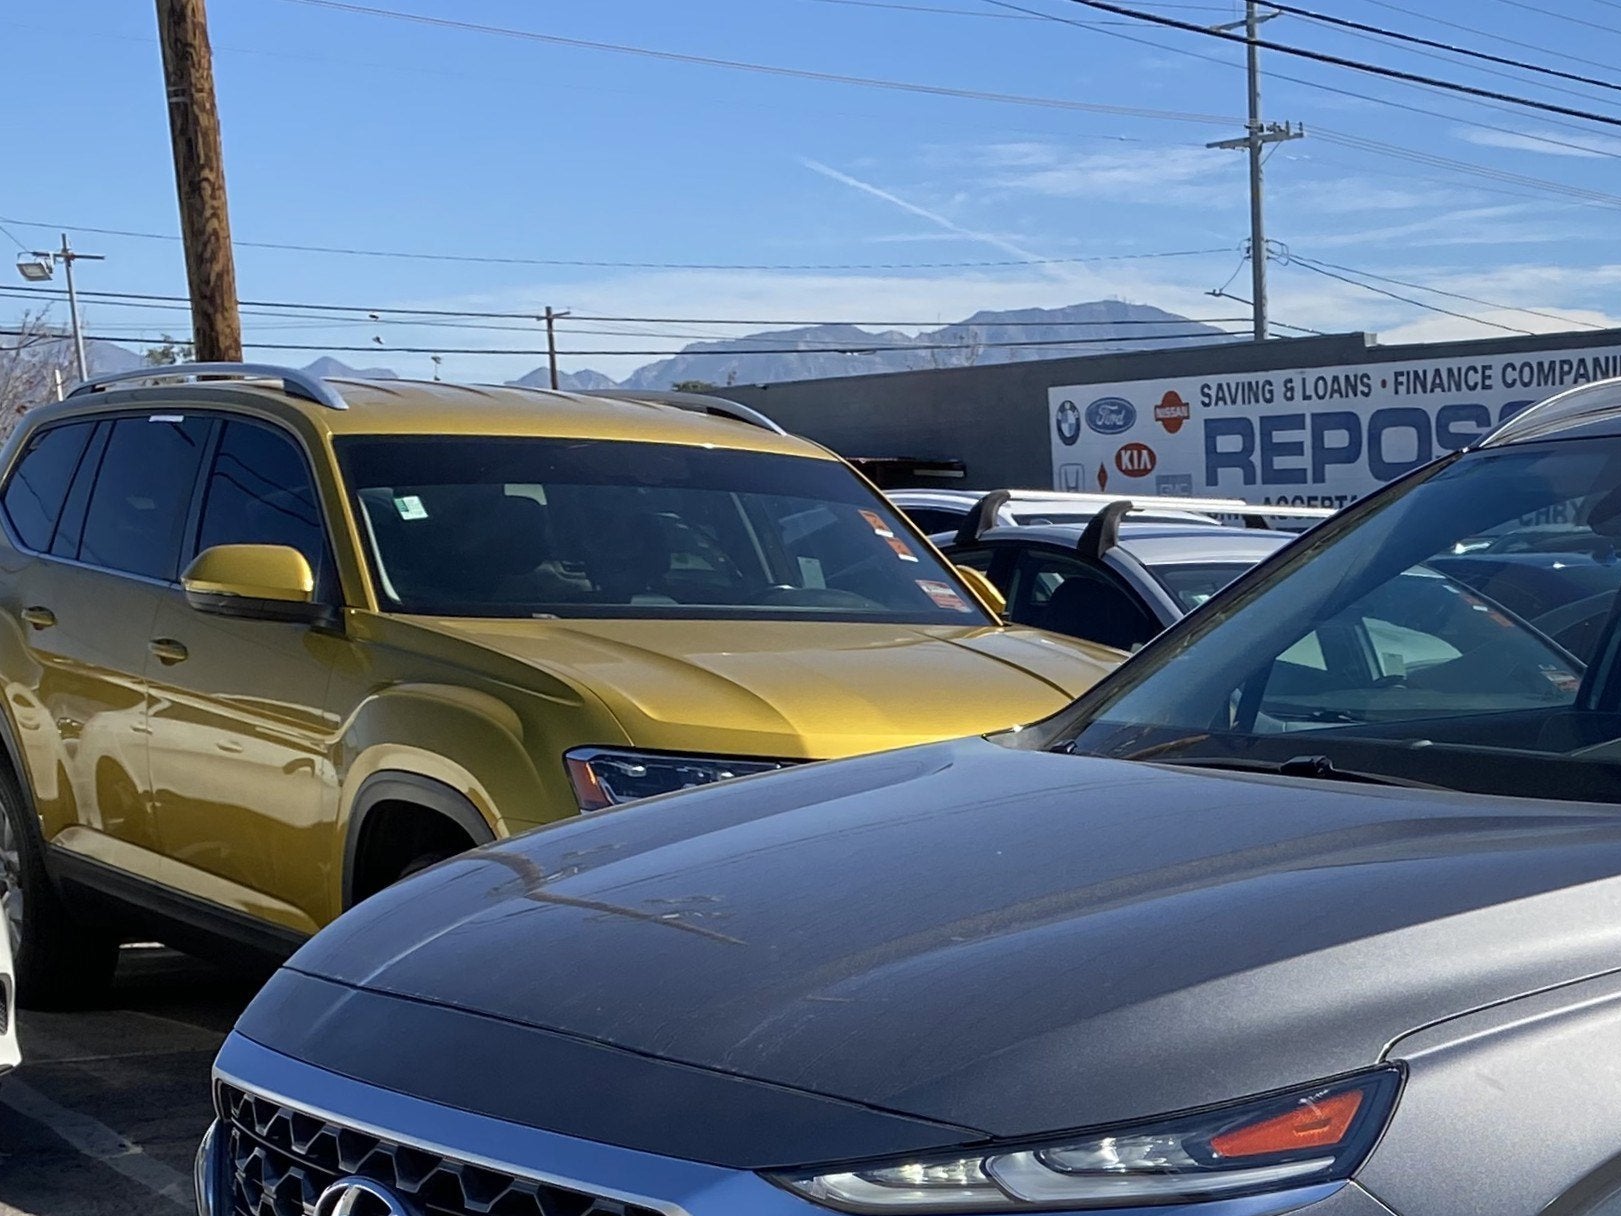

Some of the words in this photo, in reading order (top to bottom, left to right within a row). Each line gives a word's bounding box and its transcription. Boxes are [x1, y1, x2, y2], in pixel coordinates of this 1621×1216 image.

[1200, 376, 1274, 408] SAVING
[1283, 380, 1296, 403] &
[1302, 373, 1373, 401] LOANS
[1393, 364, 1494, 395] FINANCE
[1095, 404, 1126, 426] Ford
[1156, 405, 1188, 419] NISSAN
[1203, 398, 1534, 487] REPOS
[1119, 449, 1152, 471] KIA
[1263, 493, 1358, 522] ACCEPT
